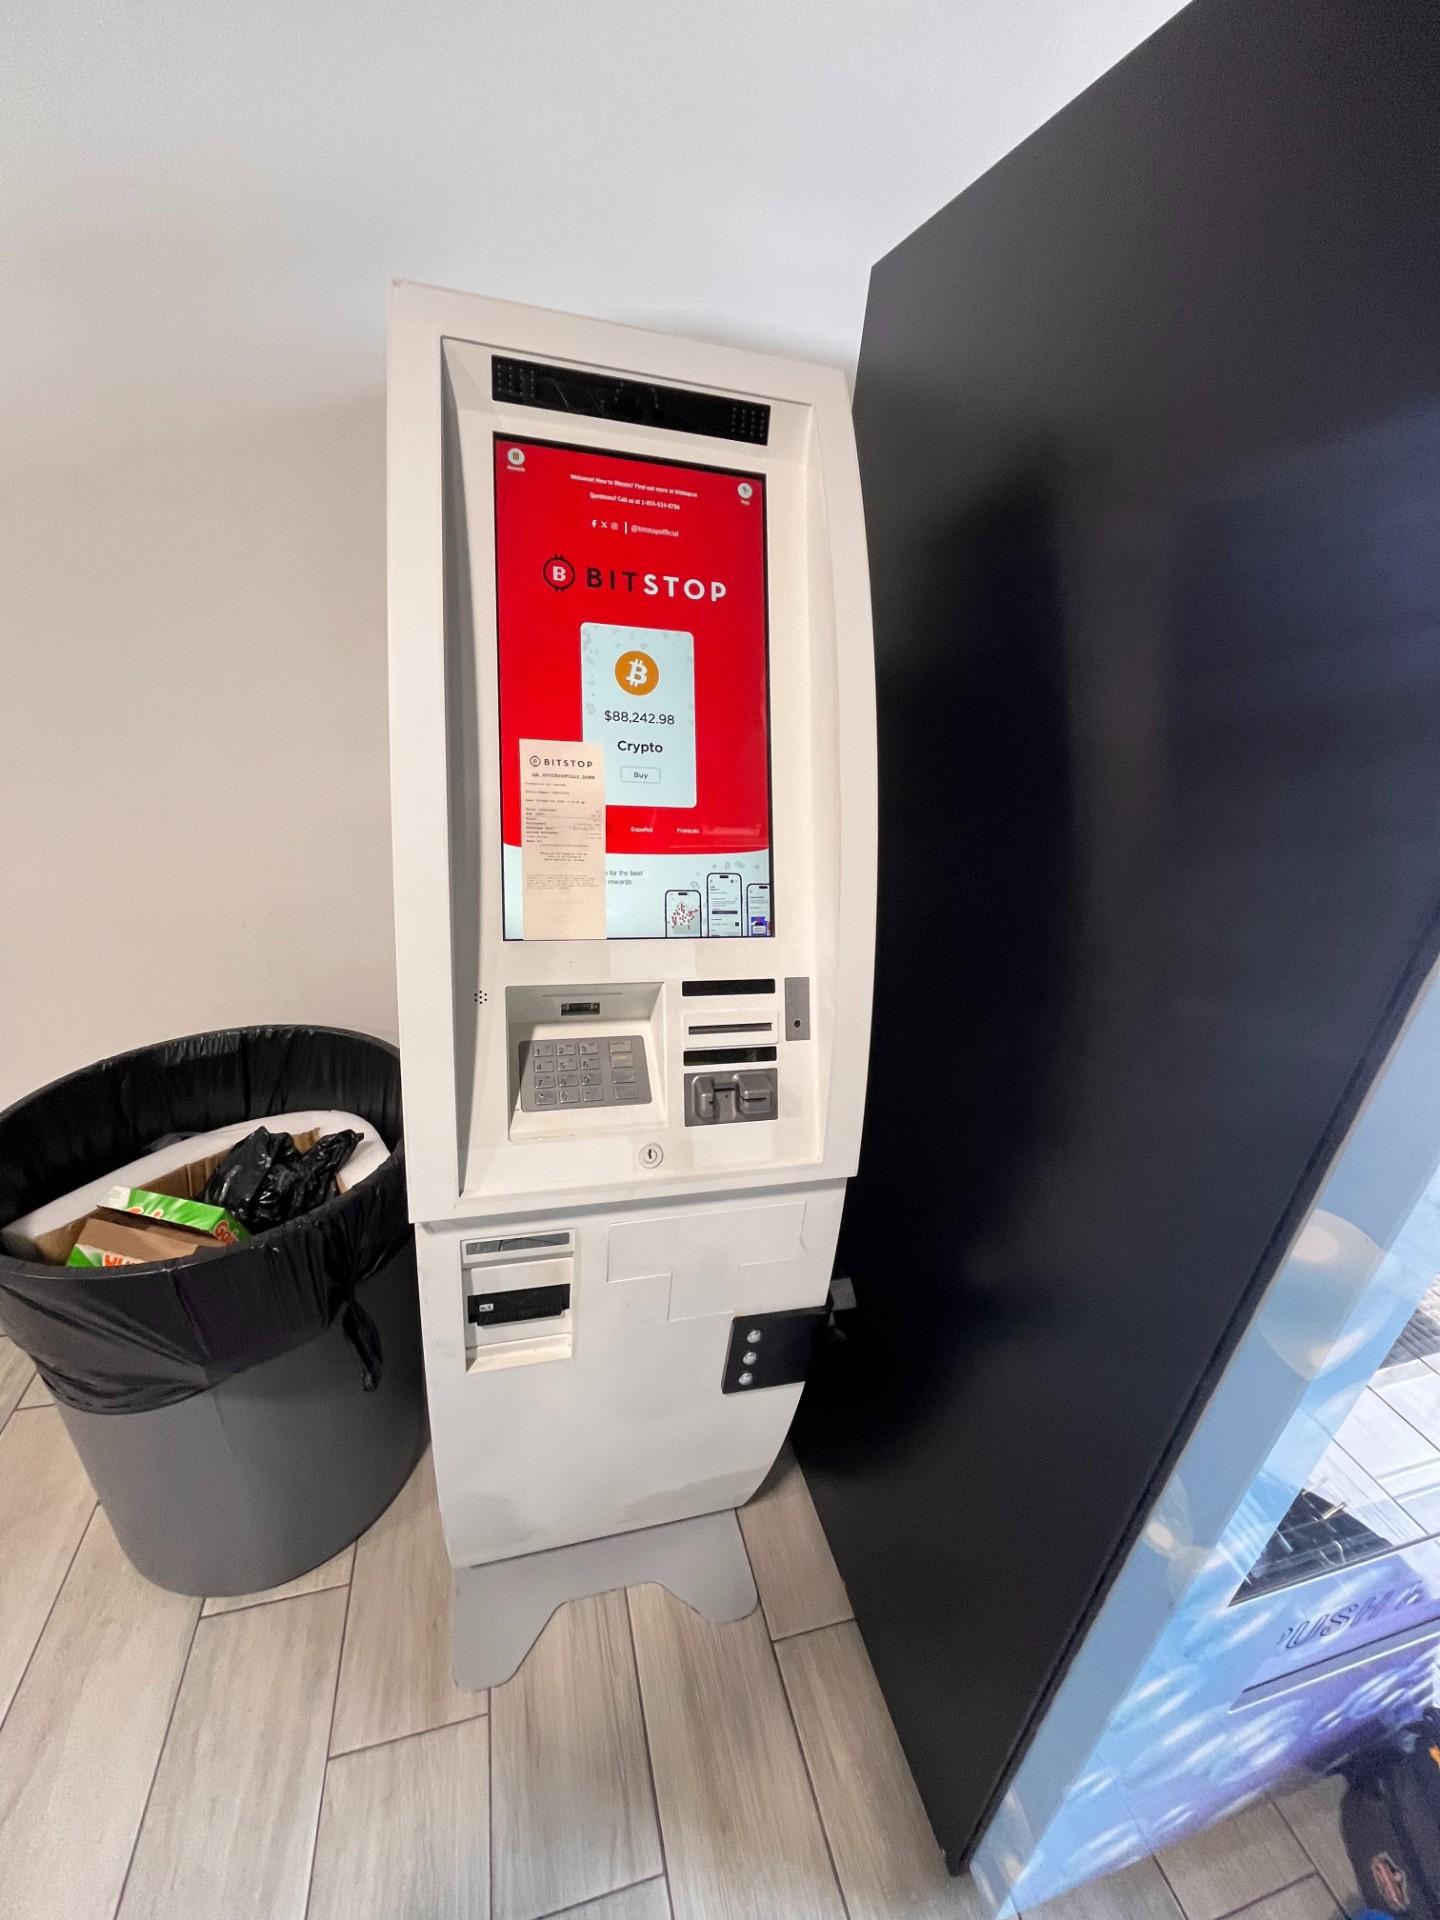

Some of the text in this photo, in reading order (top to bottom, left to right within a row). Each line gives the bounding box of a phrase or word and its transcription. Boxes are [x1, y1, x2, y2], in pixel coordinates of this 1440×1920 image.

[617, 495, 628, 503] Call
[586, 567, 727, 602] BITSTOP
[604, 710, 675, 726] $88,242.98
[617, 740, 663, 754] Crypto
[544, 758, 593, 768] BITSTOP
[633, 771, 649, 780] Buy
